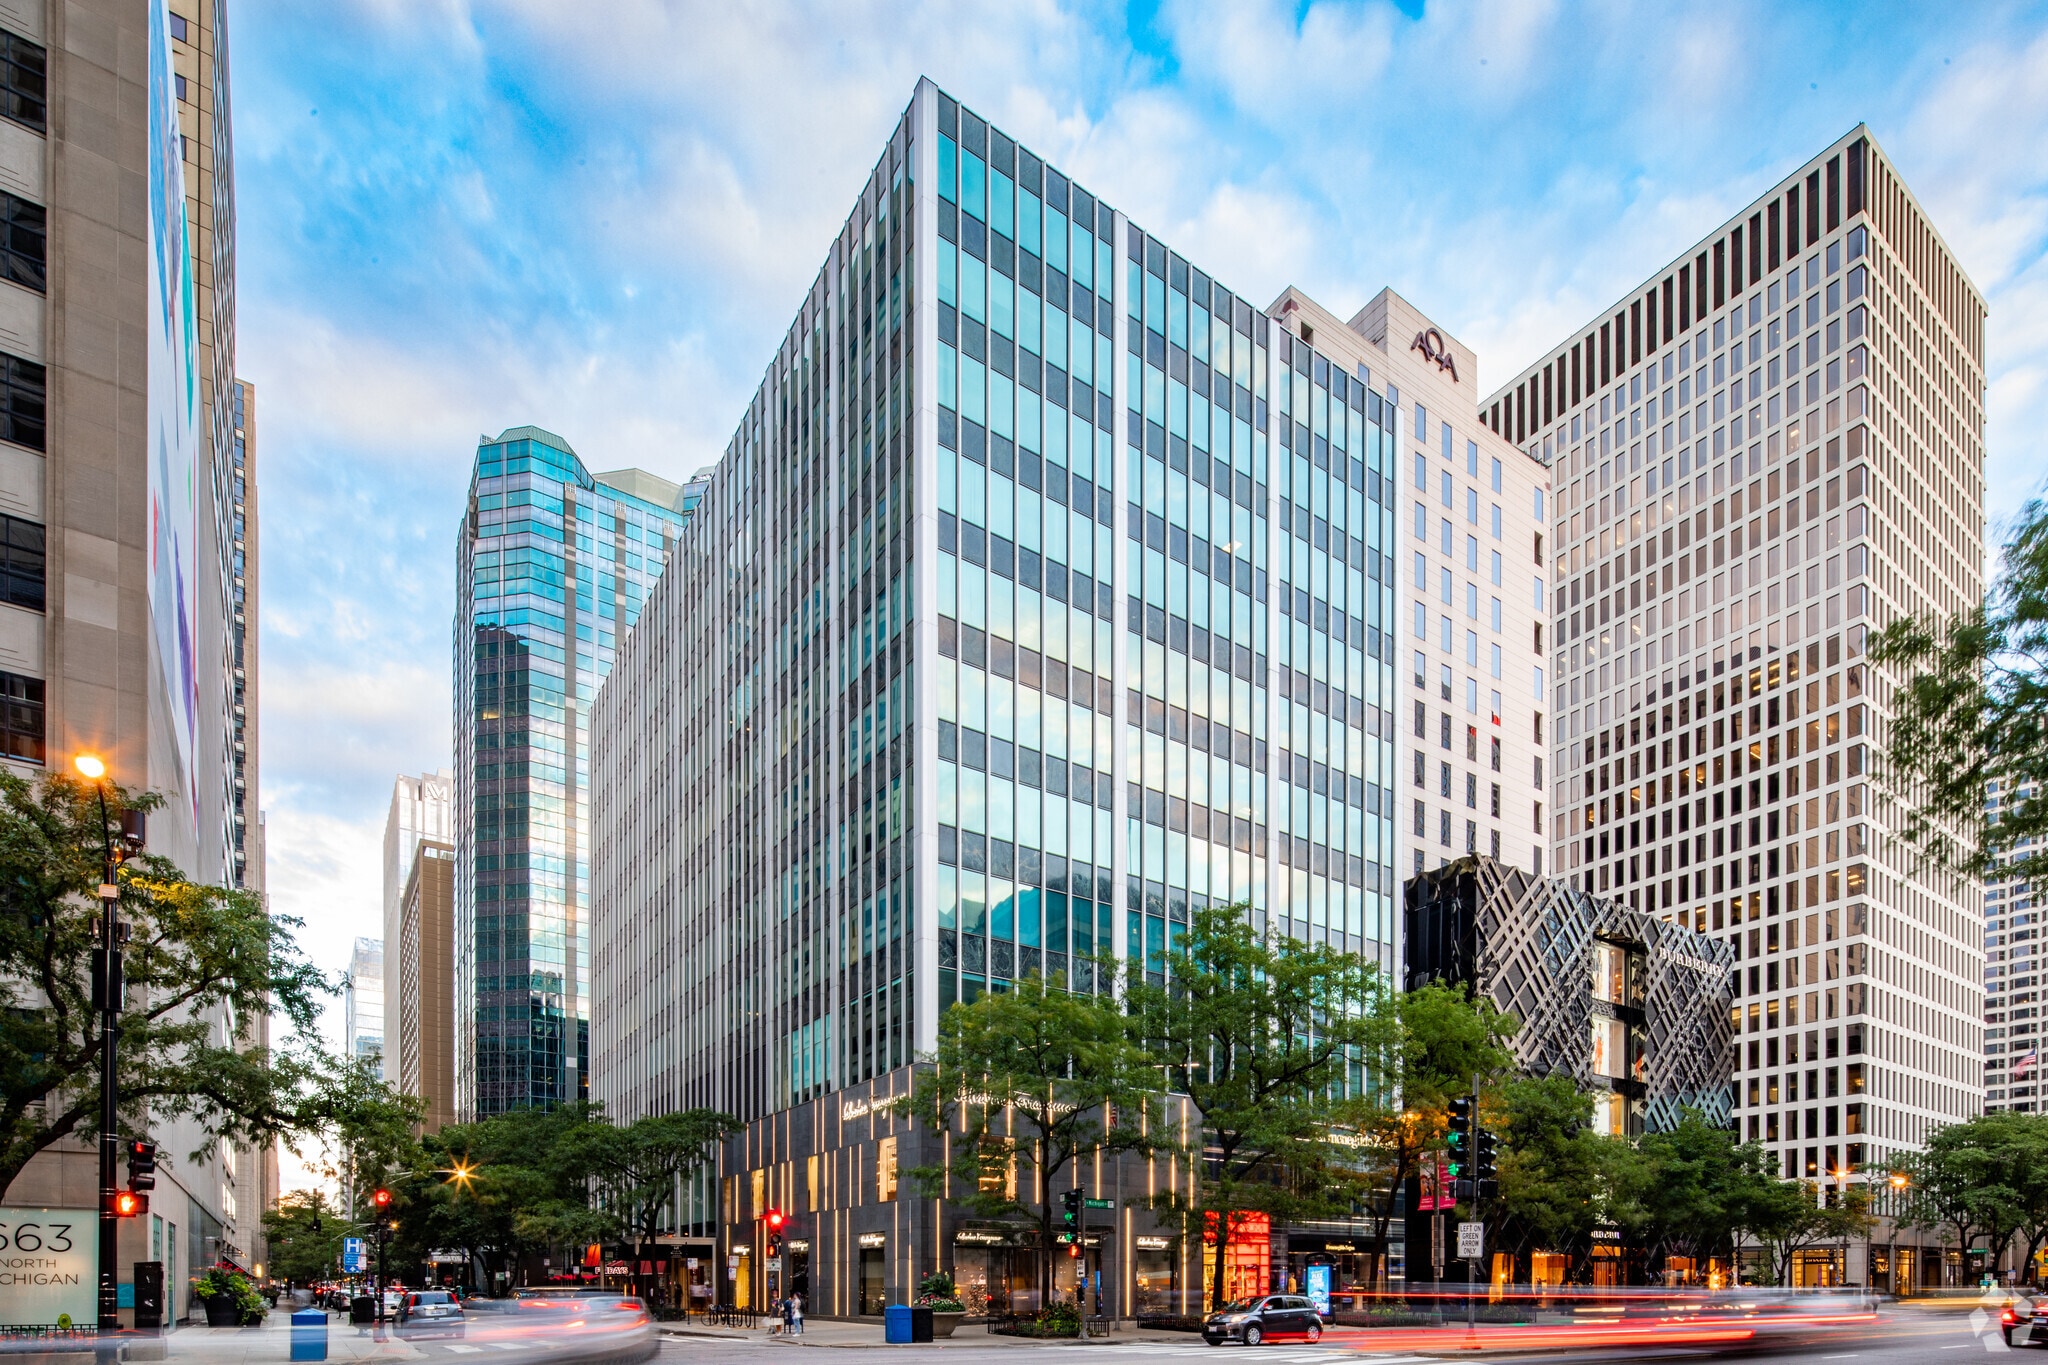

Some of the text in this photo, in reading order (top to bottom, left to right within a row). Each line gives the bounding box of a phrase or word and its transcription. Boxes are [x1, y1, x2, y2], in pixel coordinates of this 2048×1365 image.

[1659, 946, 1724, 978] BURBERRY
[346, 1239, 360, 1253] H
[0, 1258, 57, 1269] NORTH
